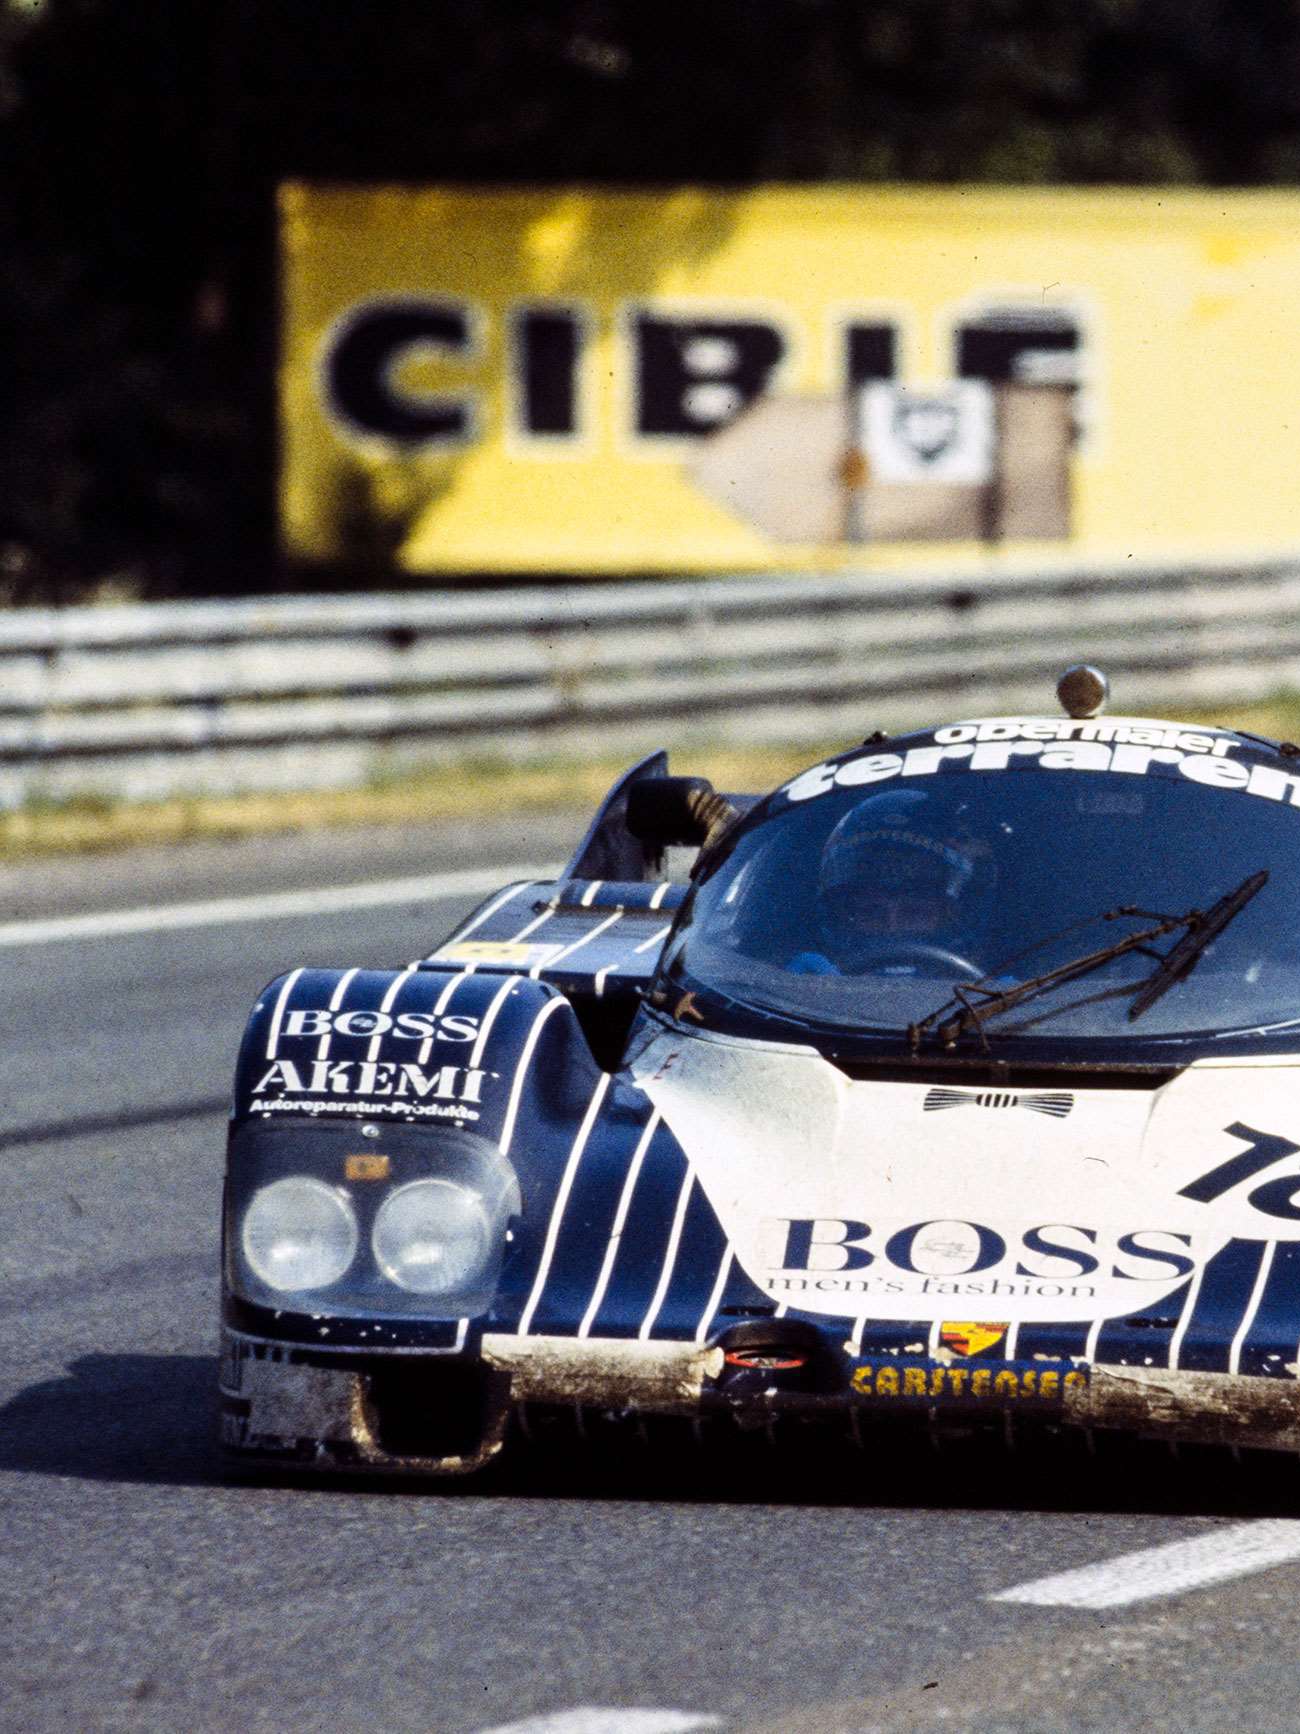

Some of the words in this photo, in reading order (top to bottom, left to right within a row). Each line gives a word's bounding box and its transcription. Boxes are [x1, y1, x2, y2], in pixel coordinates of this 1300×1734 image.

[933, 720, 1241, 757] obermaier
[280, 1010, 479, 1042] BOSS
[251, 1060, 485, 1103] AKEMI
[248, 1098, 481, 1121] Autoreparatur-Produkte
[767, 1218, 1197, 1281] BOSS
[767, 1275, 904, 1295] men's
[921, 1275, 1097, 1298] fashion
